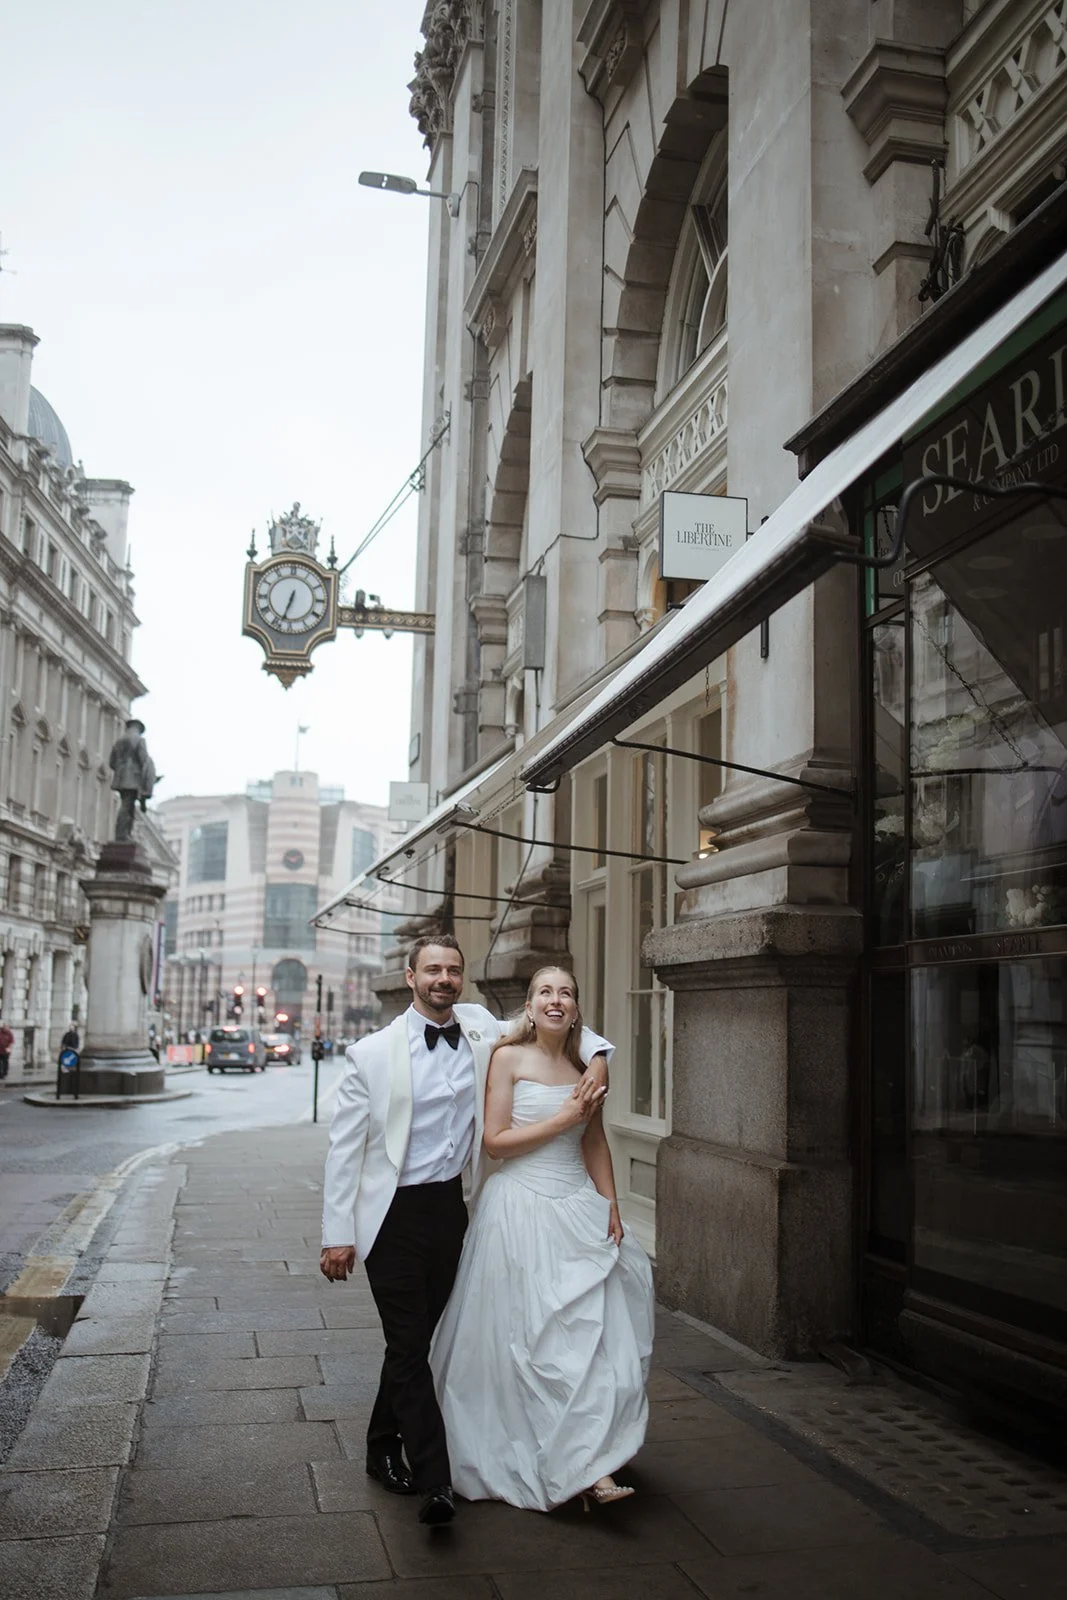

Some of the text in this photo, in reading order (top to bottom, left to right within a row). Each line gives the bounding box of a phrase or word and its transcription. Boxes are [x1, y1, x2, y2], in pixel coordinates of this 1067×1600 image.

[982, 457, 1034, 505] CMPANY
[1036, 443, 1060, 473] LTD
[694, 522, 715, 534] THE
[677, 530, 732, 547] LIBERTINE
